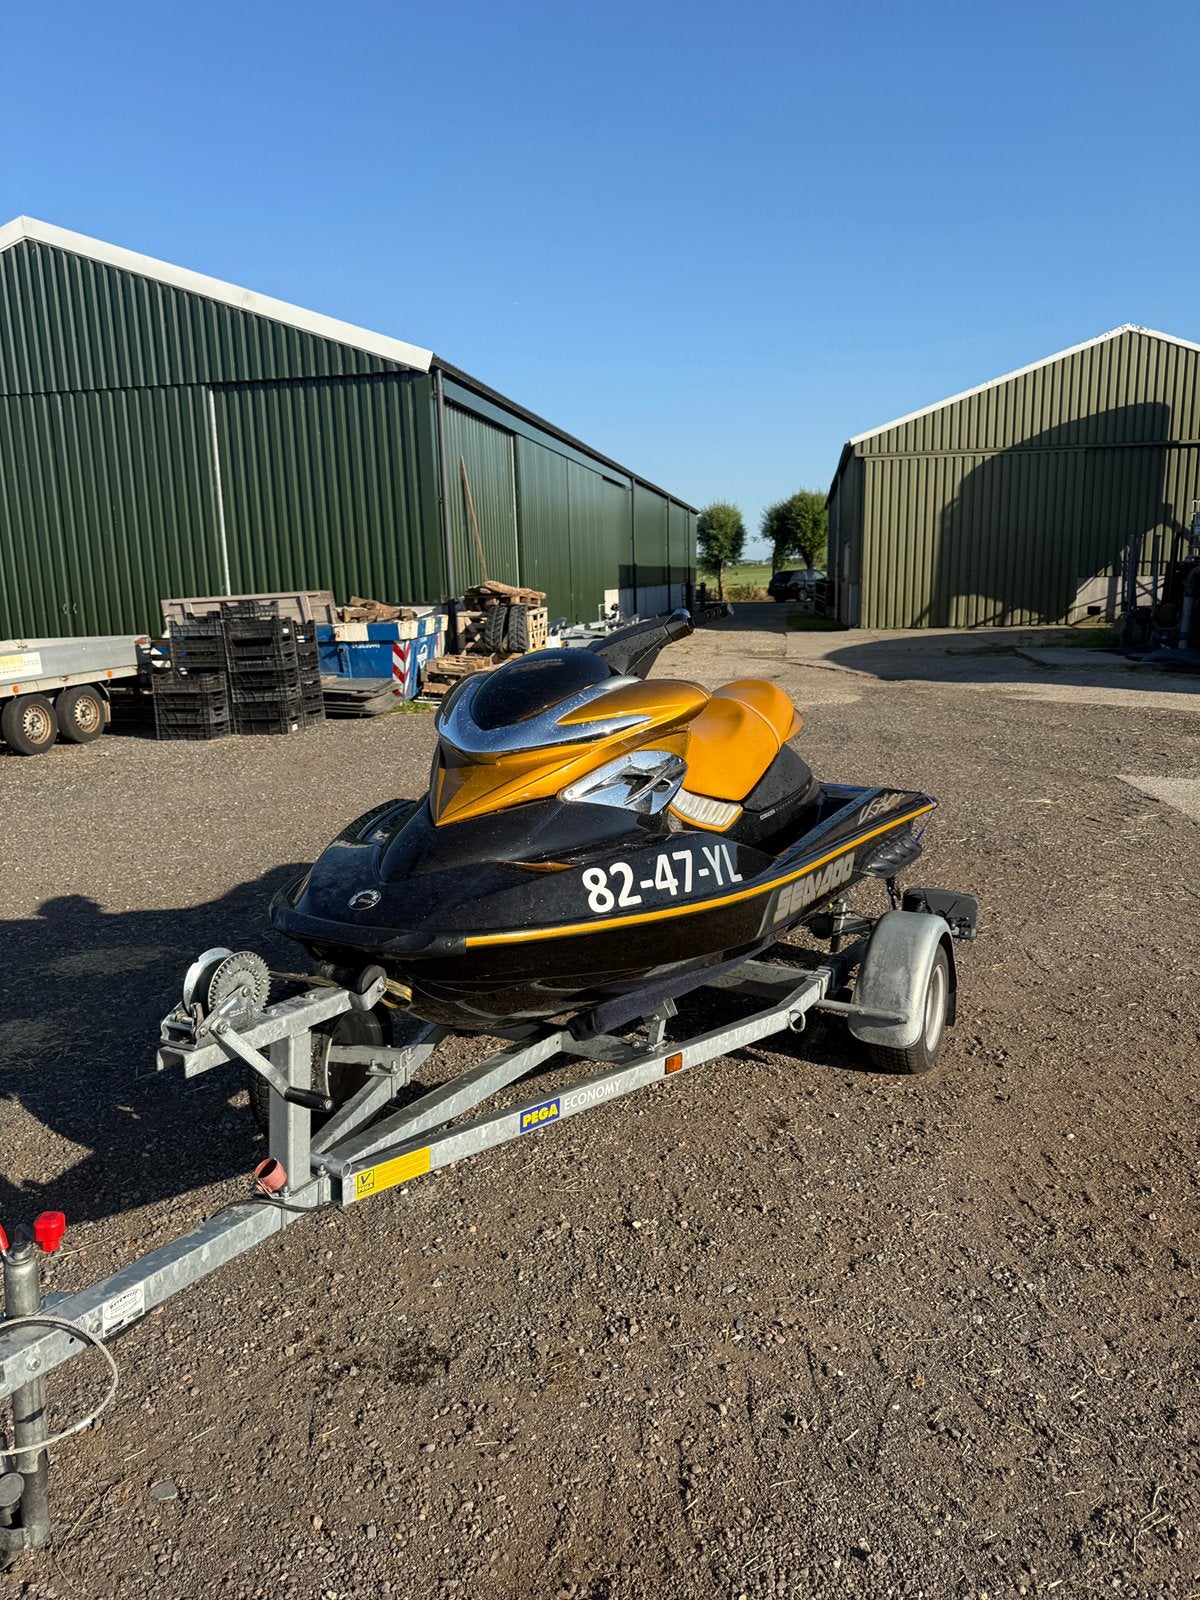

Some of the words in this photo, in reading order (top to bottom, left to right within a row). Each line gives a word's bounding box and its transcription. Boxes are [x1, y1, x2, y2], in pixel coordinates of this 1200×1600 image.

[582, 844, 743, 913] 82-47-YL
[522, 1103, 559, 1128] PEGA
[564, 1079, 621, 1111] ECONOMY
